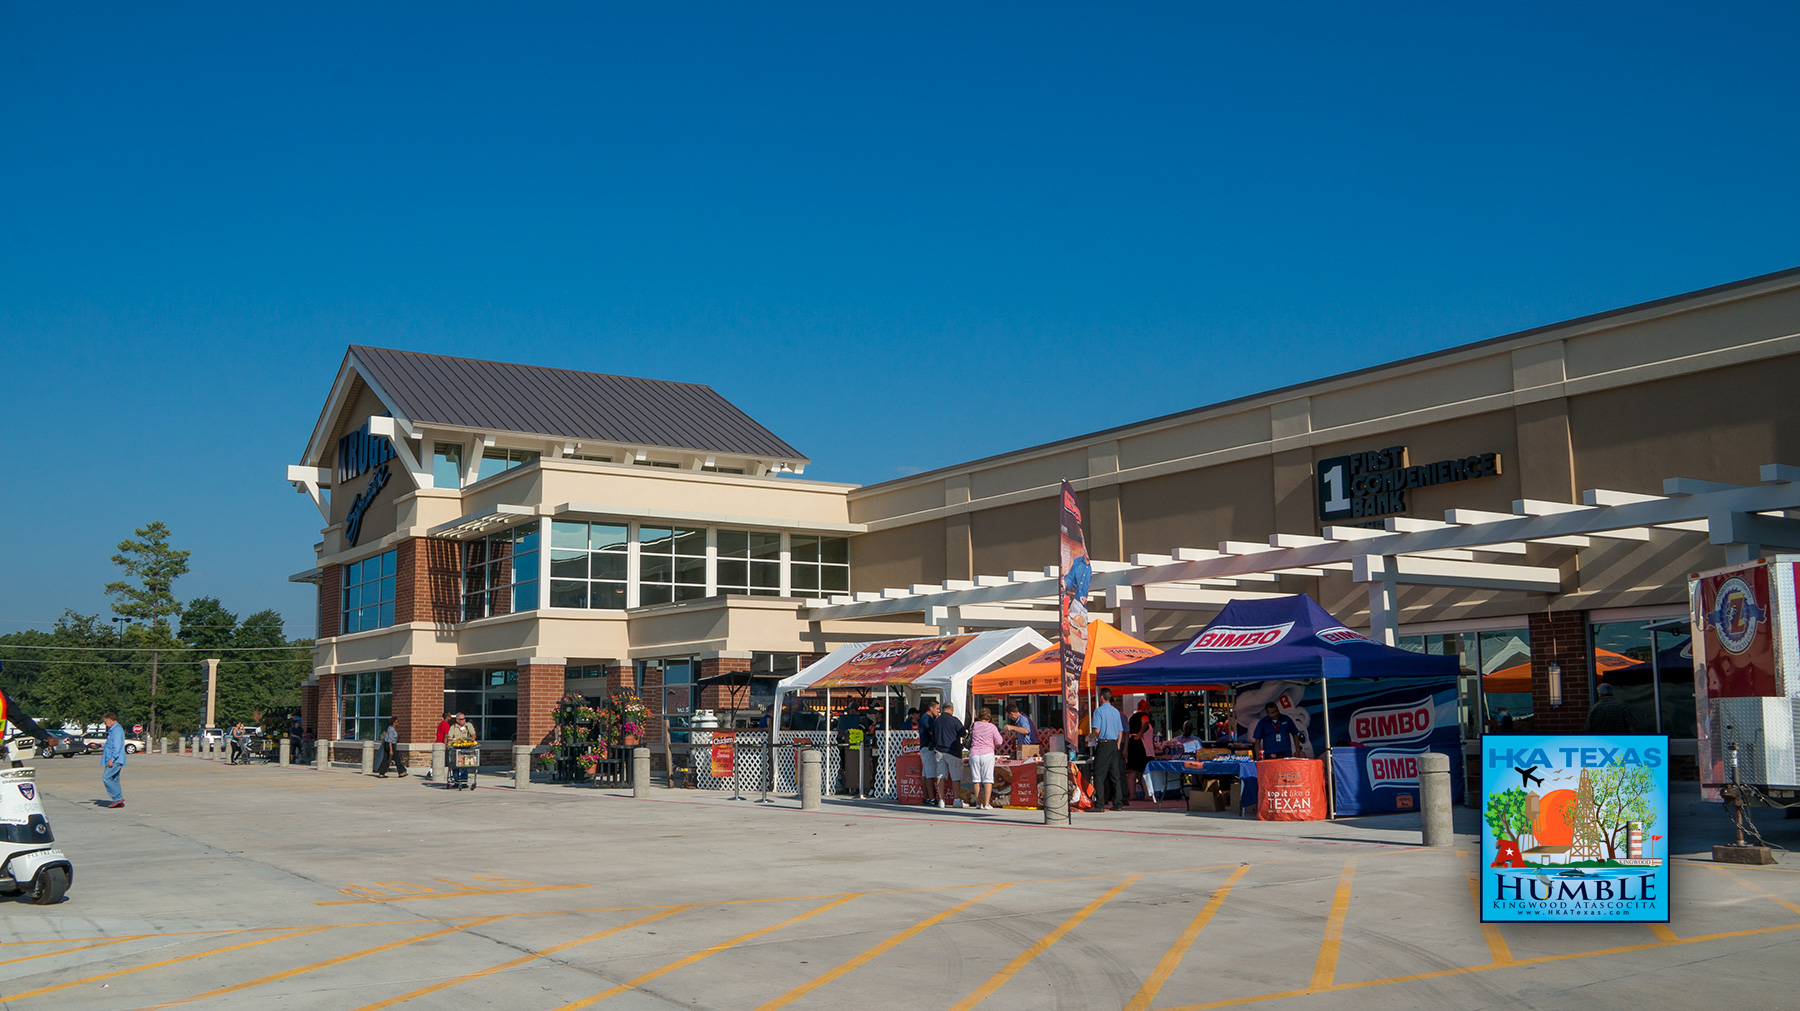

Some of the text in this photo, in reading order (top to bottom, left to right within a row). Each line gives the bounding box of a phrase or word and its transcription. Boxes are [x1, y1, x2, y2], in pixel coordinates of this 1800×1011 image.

[338, 411, 398, 485] KROGE
[1350, 445, 1410, 475] FIRST
[1323, 465, 1351, 513] 1
[1350, 452, 1503, 497] CONVENIENCE
[1351, 490, 1407, 518] BANK
[1194, 629, 1282, 648] BIMBO
[1356, 708, 1430, 738] BIMBO
[1371, 757, 1422, 780] BIMB
[1267, 790, 1280, 798] top
[1281, 789, 1288, 797] it
[1267, 798, 1311, 810] TEXAN
